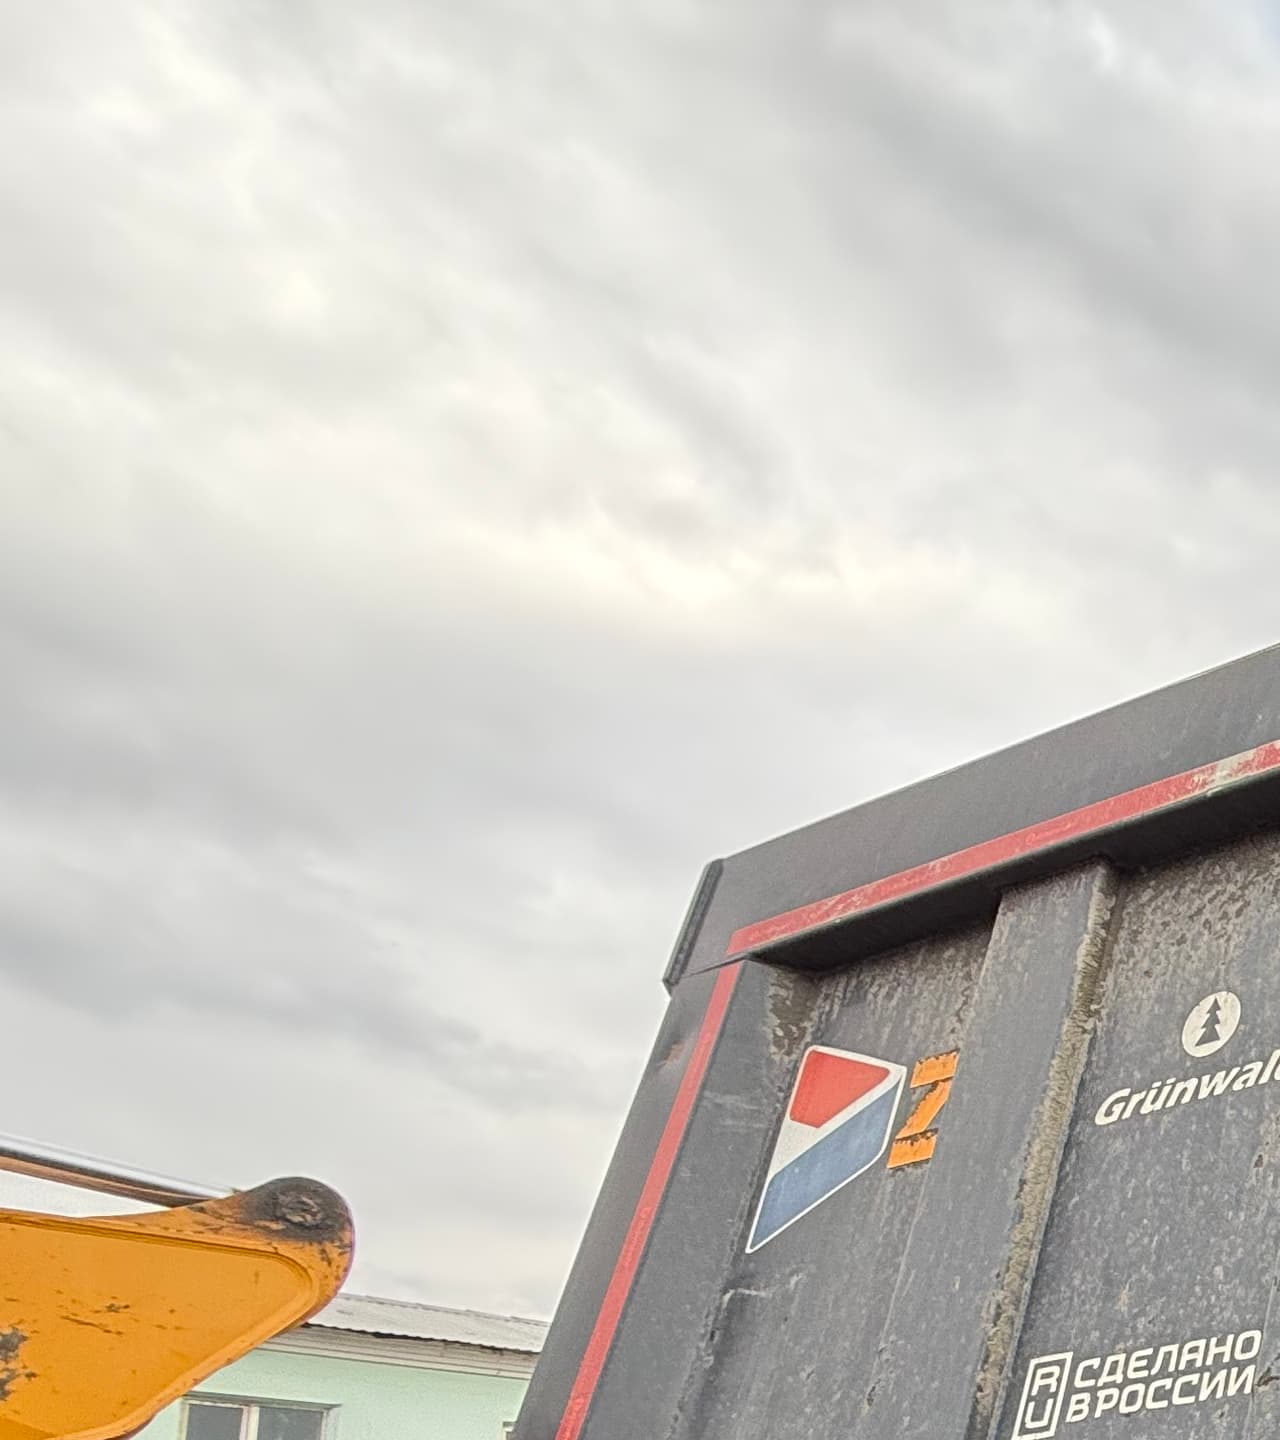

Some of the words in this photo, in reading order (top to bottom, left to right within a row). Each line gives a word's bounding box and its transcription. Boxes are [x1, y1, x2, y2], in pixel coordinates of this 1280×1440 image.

[887, 1049, 960, 1168] Z
[1074, 1329, 1262, 1389] СДЕЛАНО
[1065, 1393, 1091, 1423] В
[1094, 1364, 1257, 1419] РОССИИ
